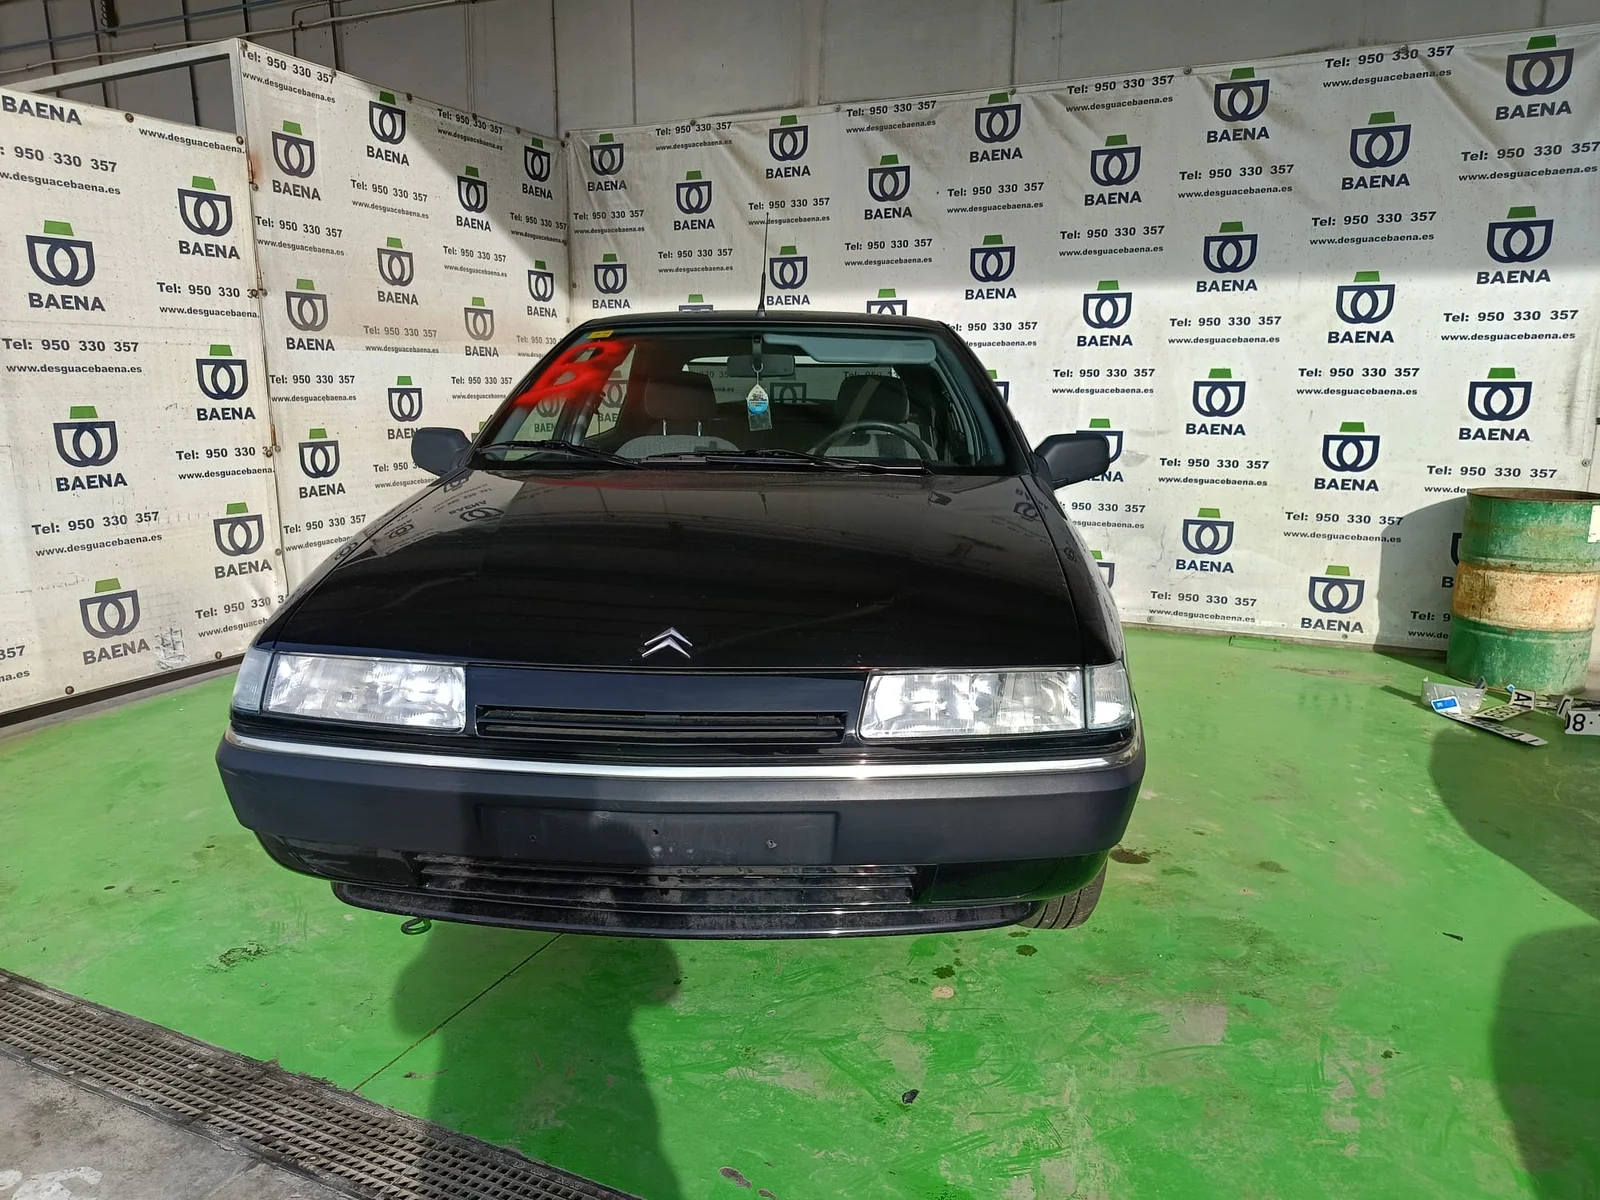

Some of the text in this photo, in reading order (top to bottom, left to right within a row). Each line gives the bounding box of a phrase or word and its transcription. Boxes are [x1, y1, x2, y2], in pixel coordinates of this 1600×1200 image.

[1, 95, 82, 126] BAENA
[1066, 95, 1173, 112] www.desguacebaena.es
[1495, 100, 1572, 121] BAENA
[1206, 126, 1270, 144] BAENA
[366, 145, 410, 166] BAENA
[969, 147, 1023, 163] BAENA
[1461, 141, 1600, 162] Tel: 950 330 357
[14, 146, 117, 172] 950 330 357
[765, 165, 811, 179] BAENA
[1179, 164, 1294, 181] Tel: 950 330 357
[1458, 166, 1598, 181] www.desguacebaena.es
[587, 180, 627, 192] BAENA
[1341, 173, 1410, 190] BAENA
[272, 179, 321, 201] BAENA
[350, 179, 428, 202] Tel: 950 330 357
[522, 182, 553, 200] BAENA
[947, 182, 1044, 197] Tel: 950 330 357
[1178, 186, 1293, 198] www.desguacebaena.es
[748, 197, 830, 211] Tel: 950 330 357
[1084, 191, 1142, 206] BAENA
[573, 209, 644, 220] Tel: 950 330 357
[864, 206, 913, 220] BAENA
[947, 202, 1044, 213] www.desguacebaena.es
[456, 215, 492, 232] BAENA
[673, 218, 715, 231] BAENA
[1311, 211, 1437, 227] Tel: 950 330 357
[1060, 225, 1165, 240] Tel: 950 330 357
[1309, 234, 1434, 245] www.desguacebaena.es
[178, 240, 241, 260] BAENA
[844, 238, 933, 251] Tel: 950 330 357
[1059, 246, 1163, 256] www.desguacebaena.es
[443, 245, 506, 262] Tel: 950 330 357
[658, 248, 733, 259] Tel: 950 330 357
[844, 256, 932, 266] www.desguacebaena.es
[1476, 269, 1551, 285] BAENA
[1196, 279, 1258, 293] BAENA
[377, 290, 419, 306] BAENA
[766, 294, 810, 306] BAENA
[965, 287, 1017, 300] BAENA
[28, 292, 106, 312] BAENA
[592, 299, 631, 309] BAENA
[527, 305, 557, 318] BAENA
[1443, 309, 1579, 322] Tel: 950 330 357
[1169, 316, 1282, 327] Tel: 950 330 357
[363, 325, 437, 338] Tel: 950 330 357
[1327, 330, 1394, 344] BAENA
[1441, 332, 1575, 342] www.desguacebaena.es
[1, 338, 139, 352] Tel: 950 330 357
[286, 337, 335, 351] BAENA
[1077, 334, 1133, 347] BAENA
[1168, 336, 1280, 345] www.desguacebaena.es
[465, 345, 499, 357] BAENA
[6, 364, 142, 375] www.desguacebaena.es
[1053, 368, 1155, 378] Tel: 950 330 357
[1298, 367, 1420, 377] Tel: 950 330 357
[269, 374, 355, 384] Tel: 950 330 357
[271, 394, 357, 403] www.desguacebaena.es
[1296, 387, 1417, 396] www.desguacebaena.es
[196, 407, 256, 421] BAENA
[1185, 423, 1246, 436] BAENA
[1458, 427, 1530, 441] BAENA
[1159, 457, 1269, 469] Tel: 950 330 357
[1427, 465, 1558, 478] Tel: 950 330 357
[55, 472, 128, 492] BAENA
[1314, 477, 1379, 492] BAENA
[299, 482, 346, 499] BAENA
[31, 511, 159, 535] Tel: 950 330 357
[1285, 511, 1404, 526] Tel: 950 330 357
[1283, 530, 1401, 543] www.desguacebaena.es
[35, 534, 162, 557] www.desguacebaena.es
[214, 559, 273, 579] BAENA
[1176, 559, 1234, 574] BAENA
[1150, 591, 1257, 607] Tel: 950 330 357
[1301, 617, 1364, 633] BAENA
[83, 638, 151, 665] BAENA
